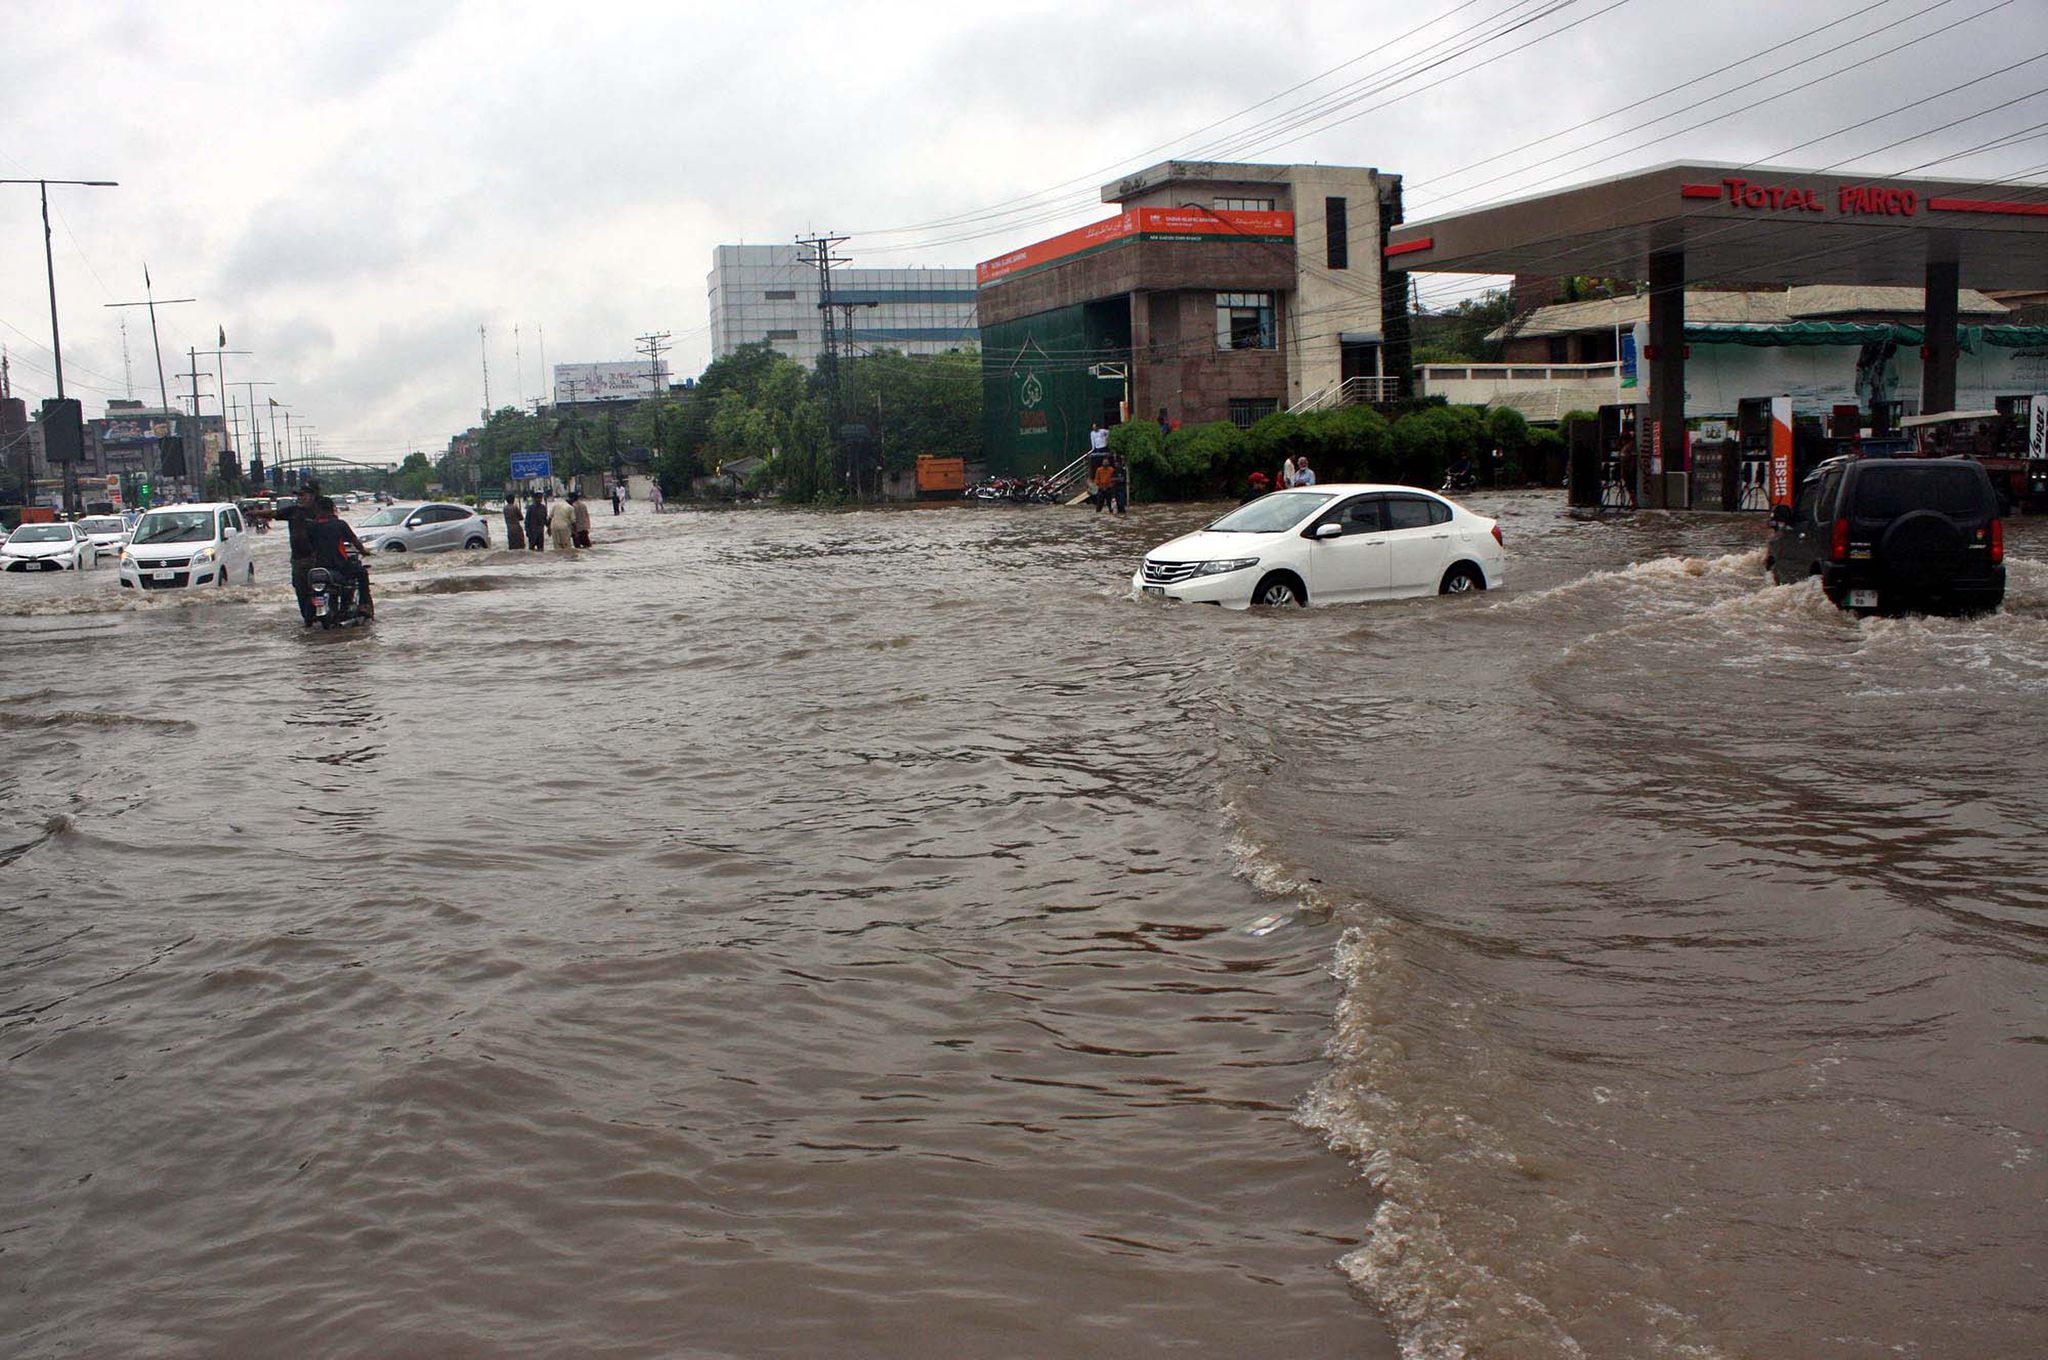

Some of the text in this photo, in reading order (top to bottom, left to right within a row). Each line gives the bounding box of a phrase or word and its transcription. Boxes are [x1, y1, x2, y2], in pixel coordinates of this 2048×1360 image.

[1723, 178, 1918, 216] TOTAL PARCO
[1774, 454, 1788, 497] DIESEL
